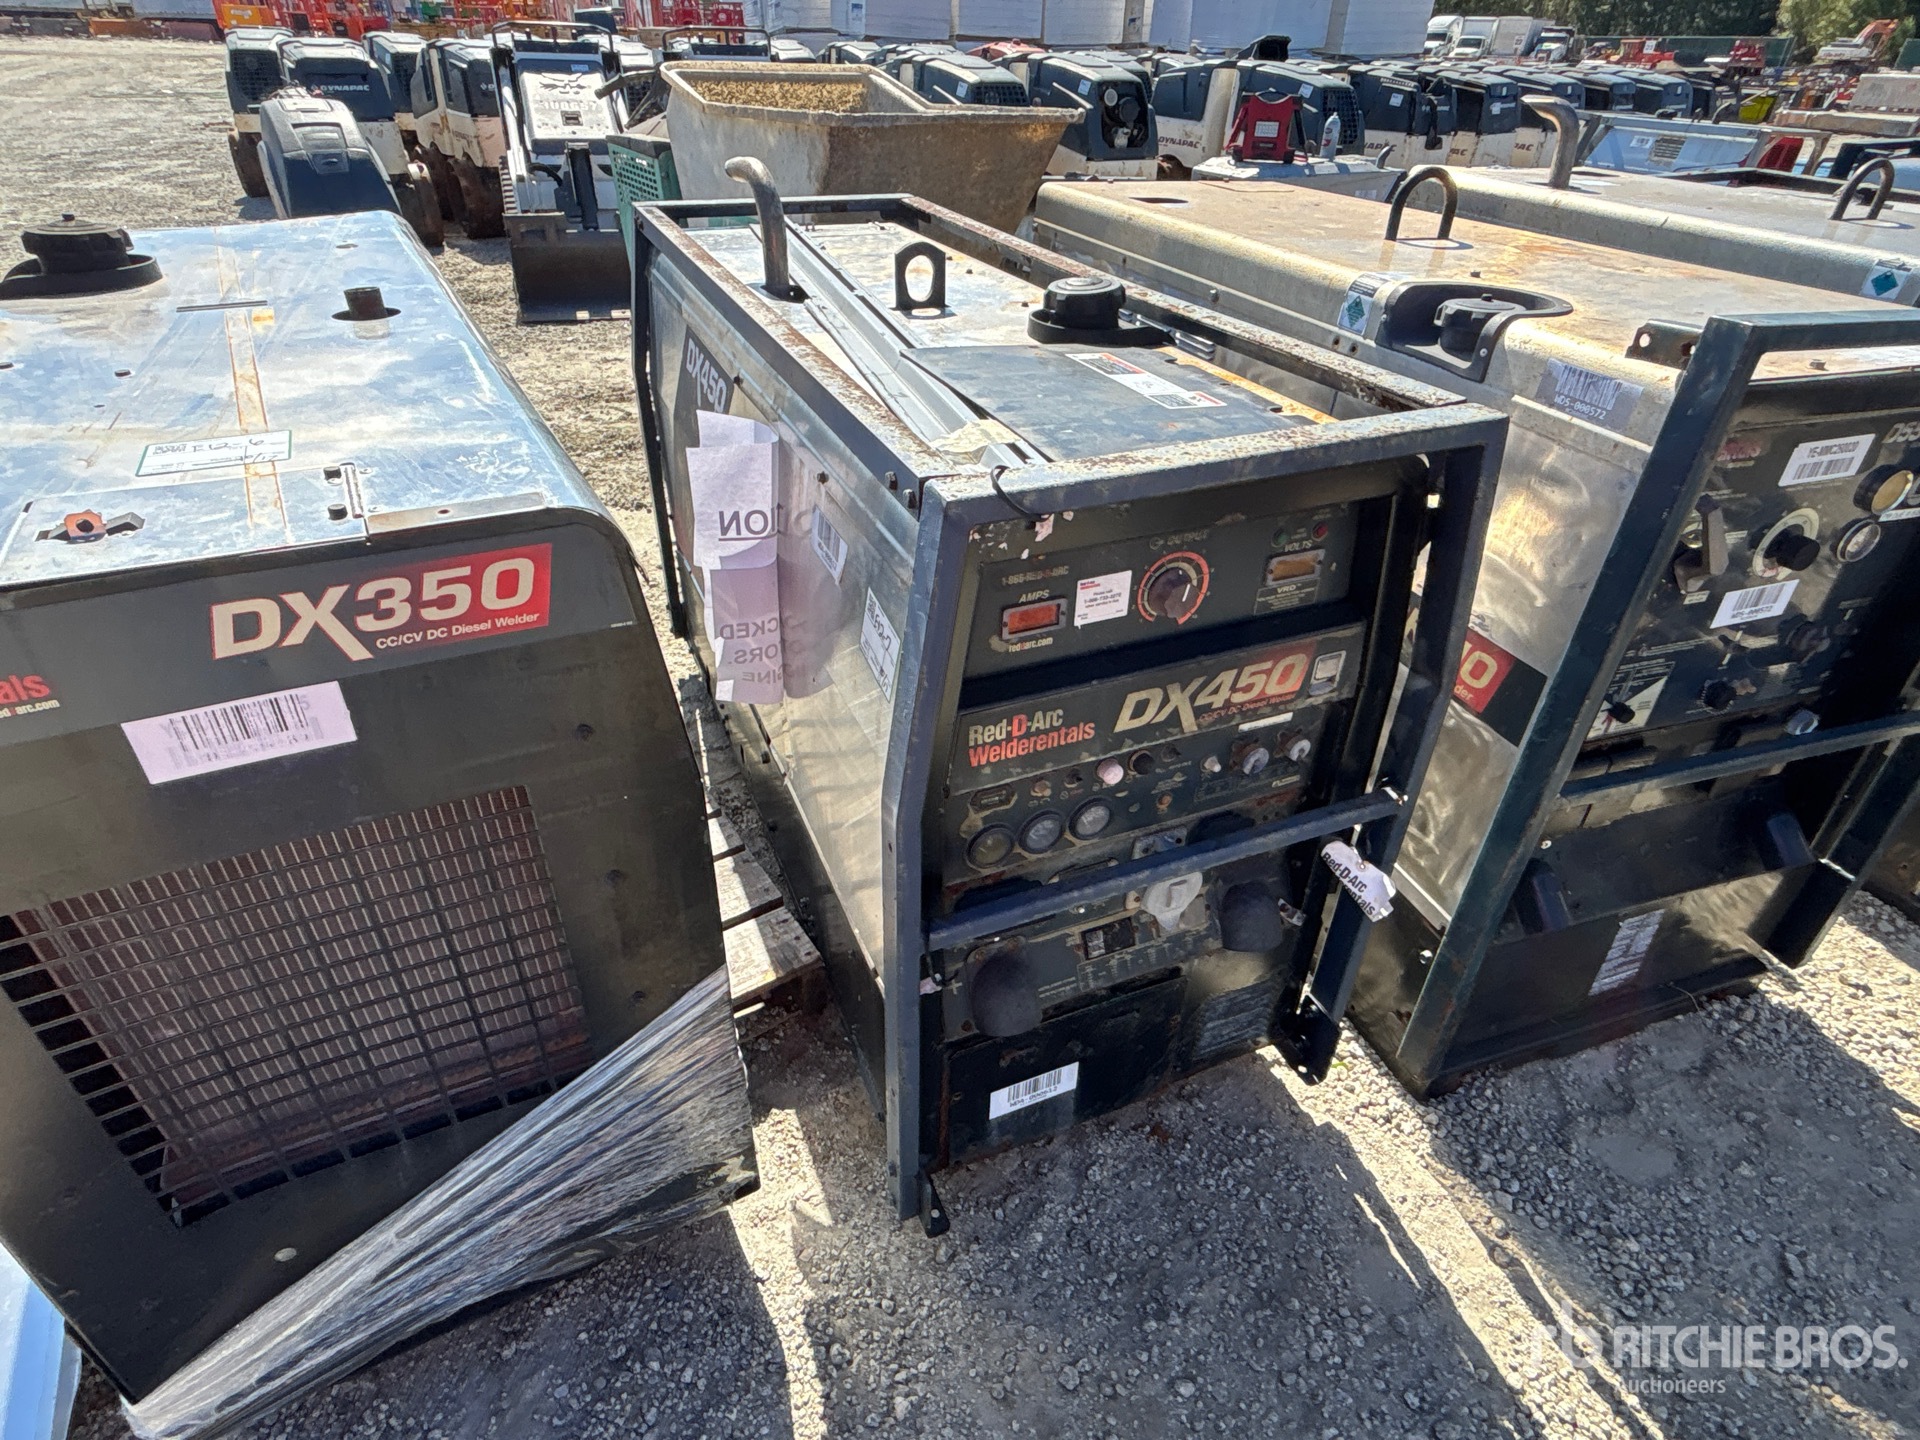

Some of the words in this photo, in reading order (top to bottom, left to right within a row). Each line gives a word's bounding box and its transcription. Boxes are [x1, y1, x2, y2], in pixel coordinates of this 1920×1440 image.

[319, 84, 370, 92] DYNAPAC
[1158, 136, 1200, 149] DYNAPAC
[211, 556, 536, 662] DX350
[1018, 589, 1050, 604] AMPS
[376, 630, 424, 650] CC/CV
[427, 627, 448, 641] DC
[451, 618, 492, 636] Diesel
[494, 612, 540, 629] Welder
[1113, 652, 1308, 733] DX450
[968, 707, 1064, 748] Red-D-Arc
[968, 721, 1096, 768] Welderentals
[1322, 852, 1368, 893] Red-D-Arc
